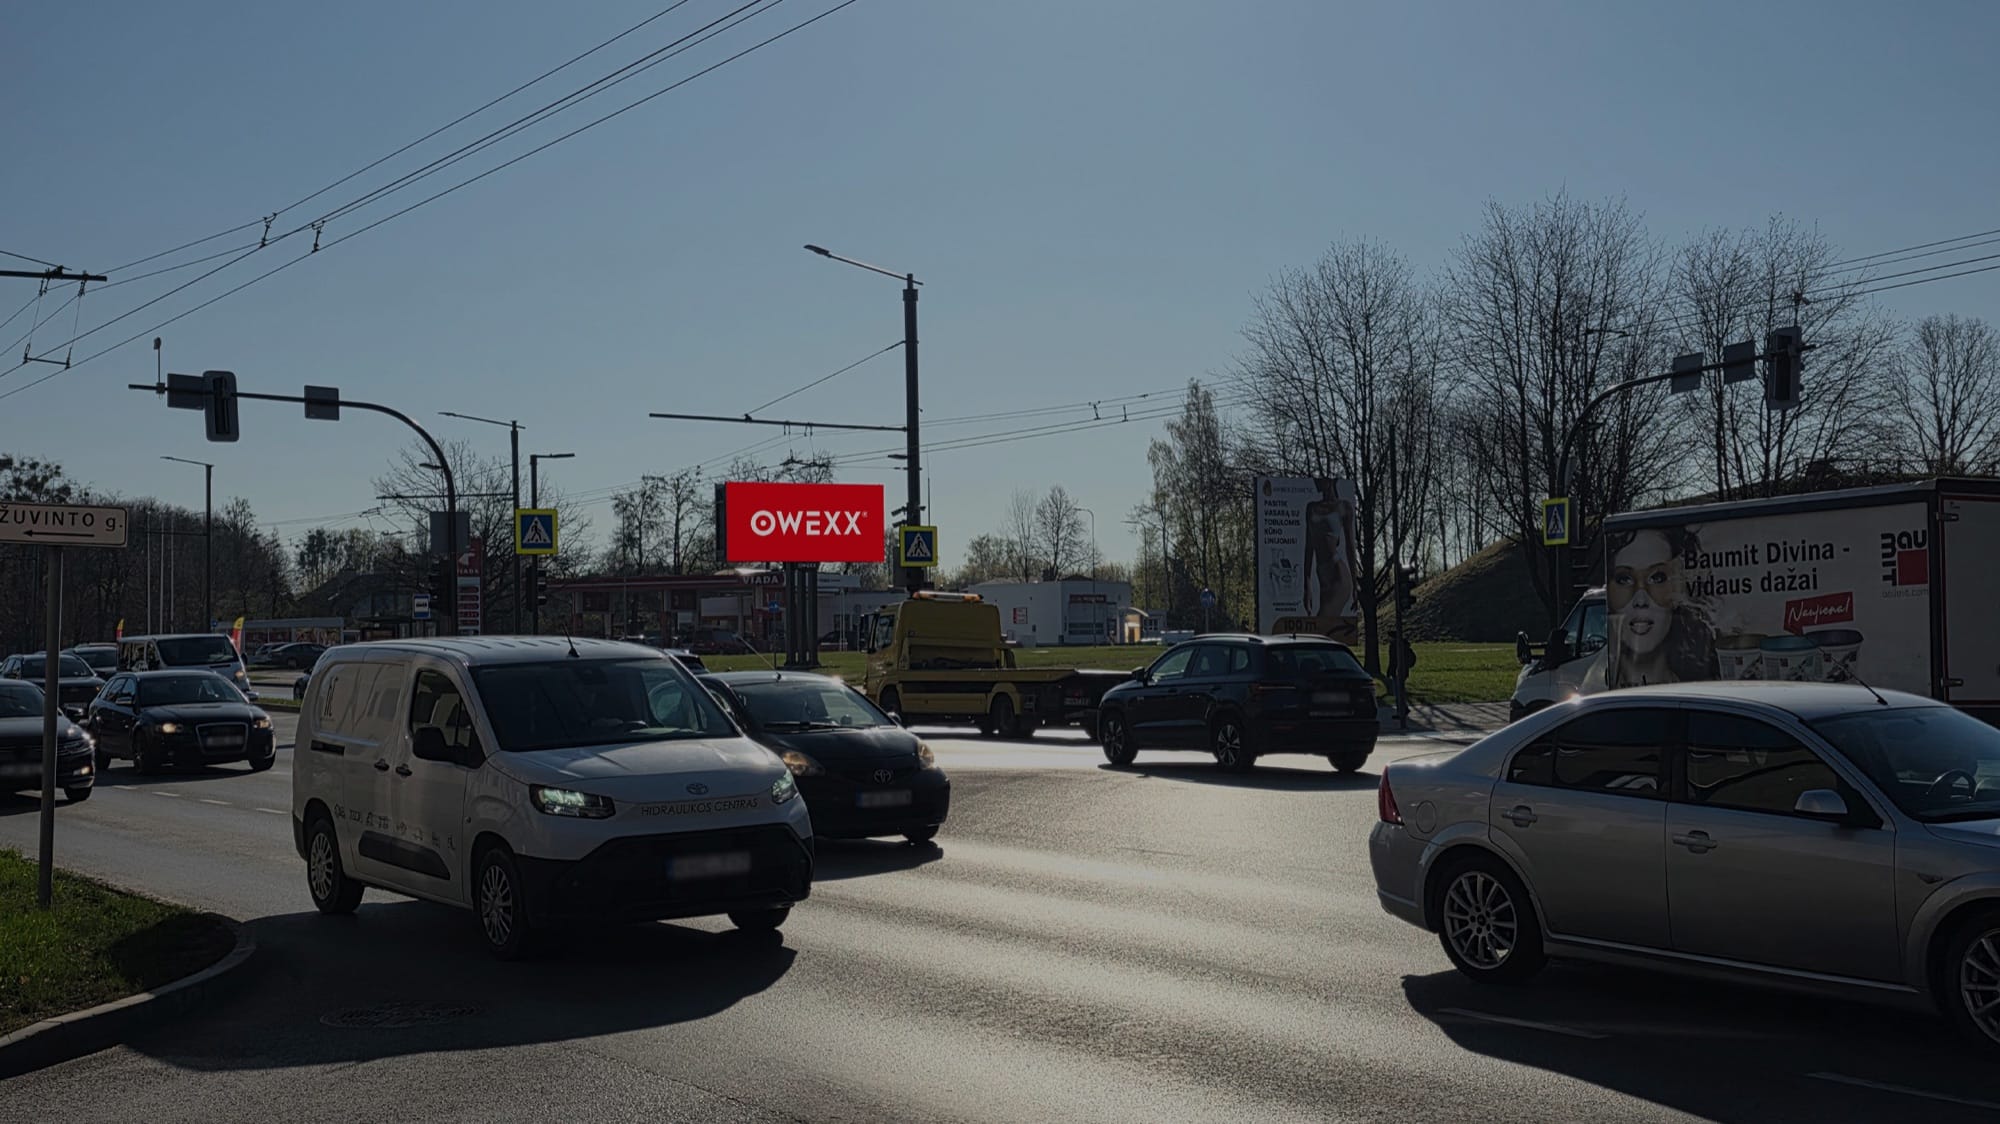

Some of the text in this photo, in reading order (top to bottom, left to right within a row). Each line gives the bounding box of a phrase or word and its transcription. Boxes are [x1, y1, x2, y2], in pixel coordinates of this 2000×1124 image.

[0, 505, 123, 532] ŽUVINTO g.
[750, 509, 862, 537] OWEXX
[1684, 544, 1759, 570] Baumit
[1766, 539, 1834, 564] Divina
[743, 575, 780, 585] VIADA
[1686, 567, 1818, 598] vidaus dažai
[1284, 619, 1318, 634] 100 m
[641, 799, 759, 817] HIDRAULIKOS CENTRAS
